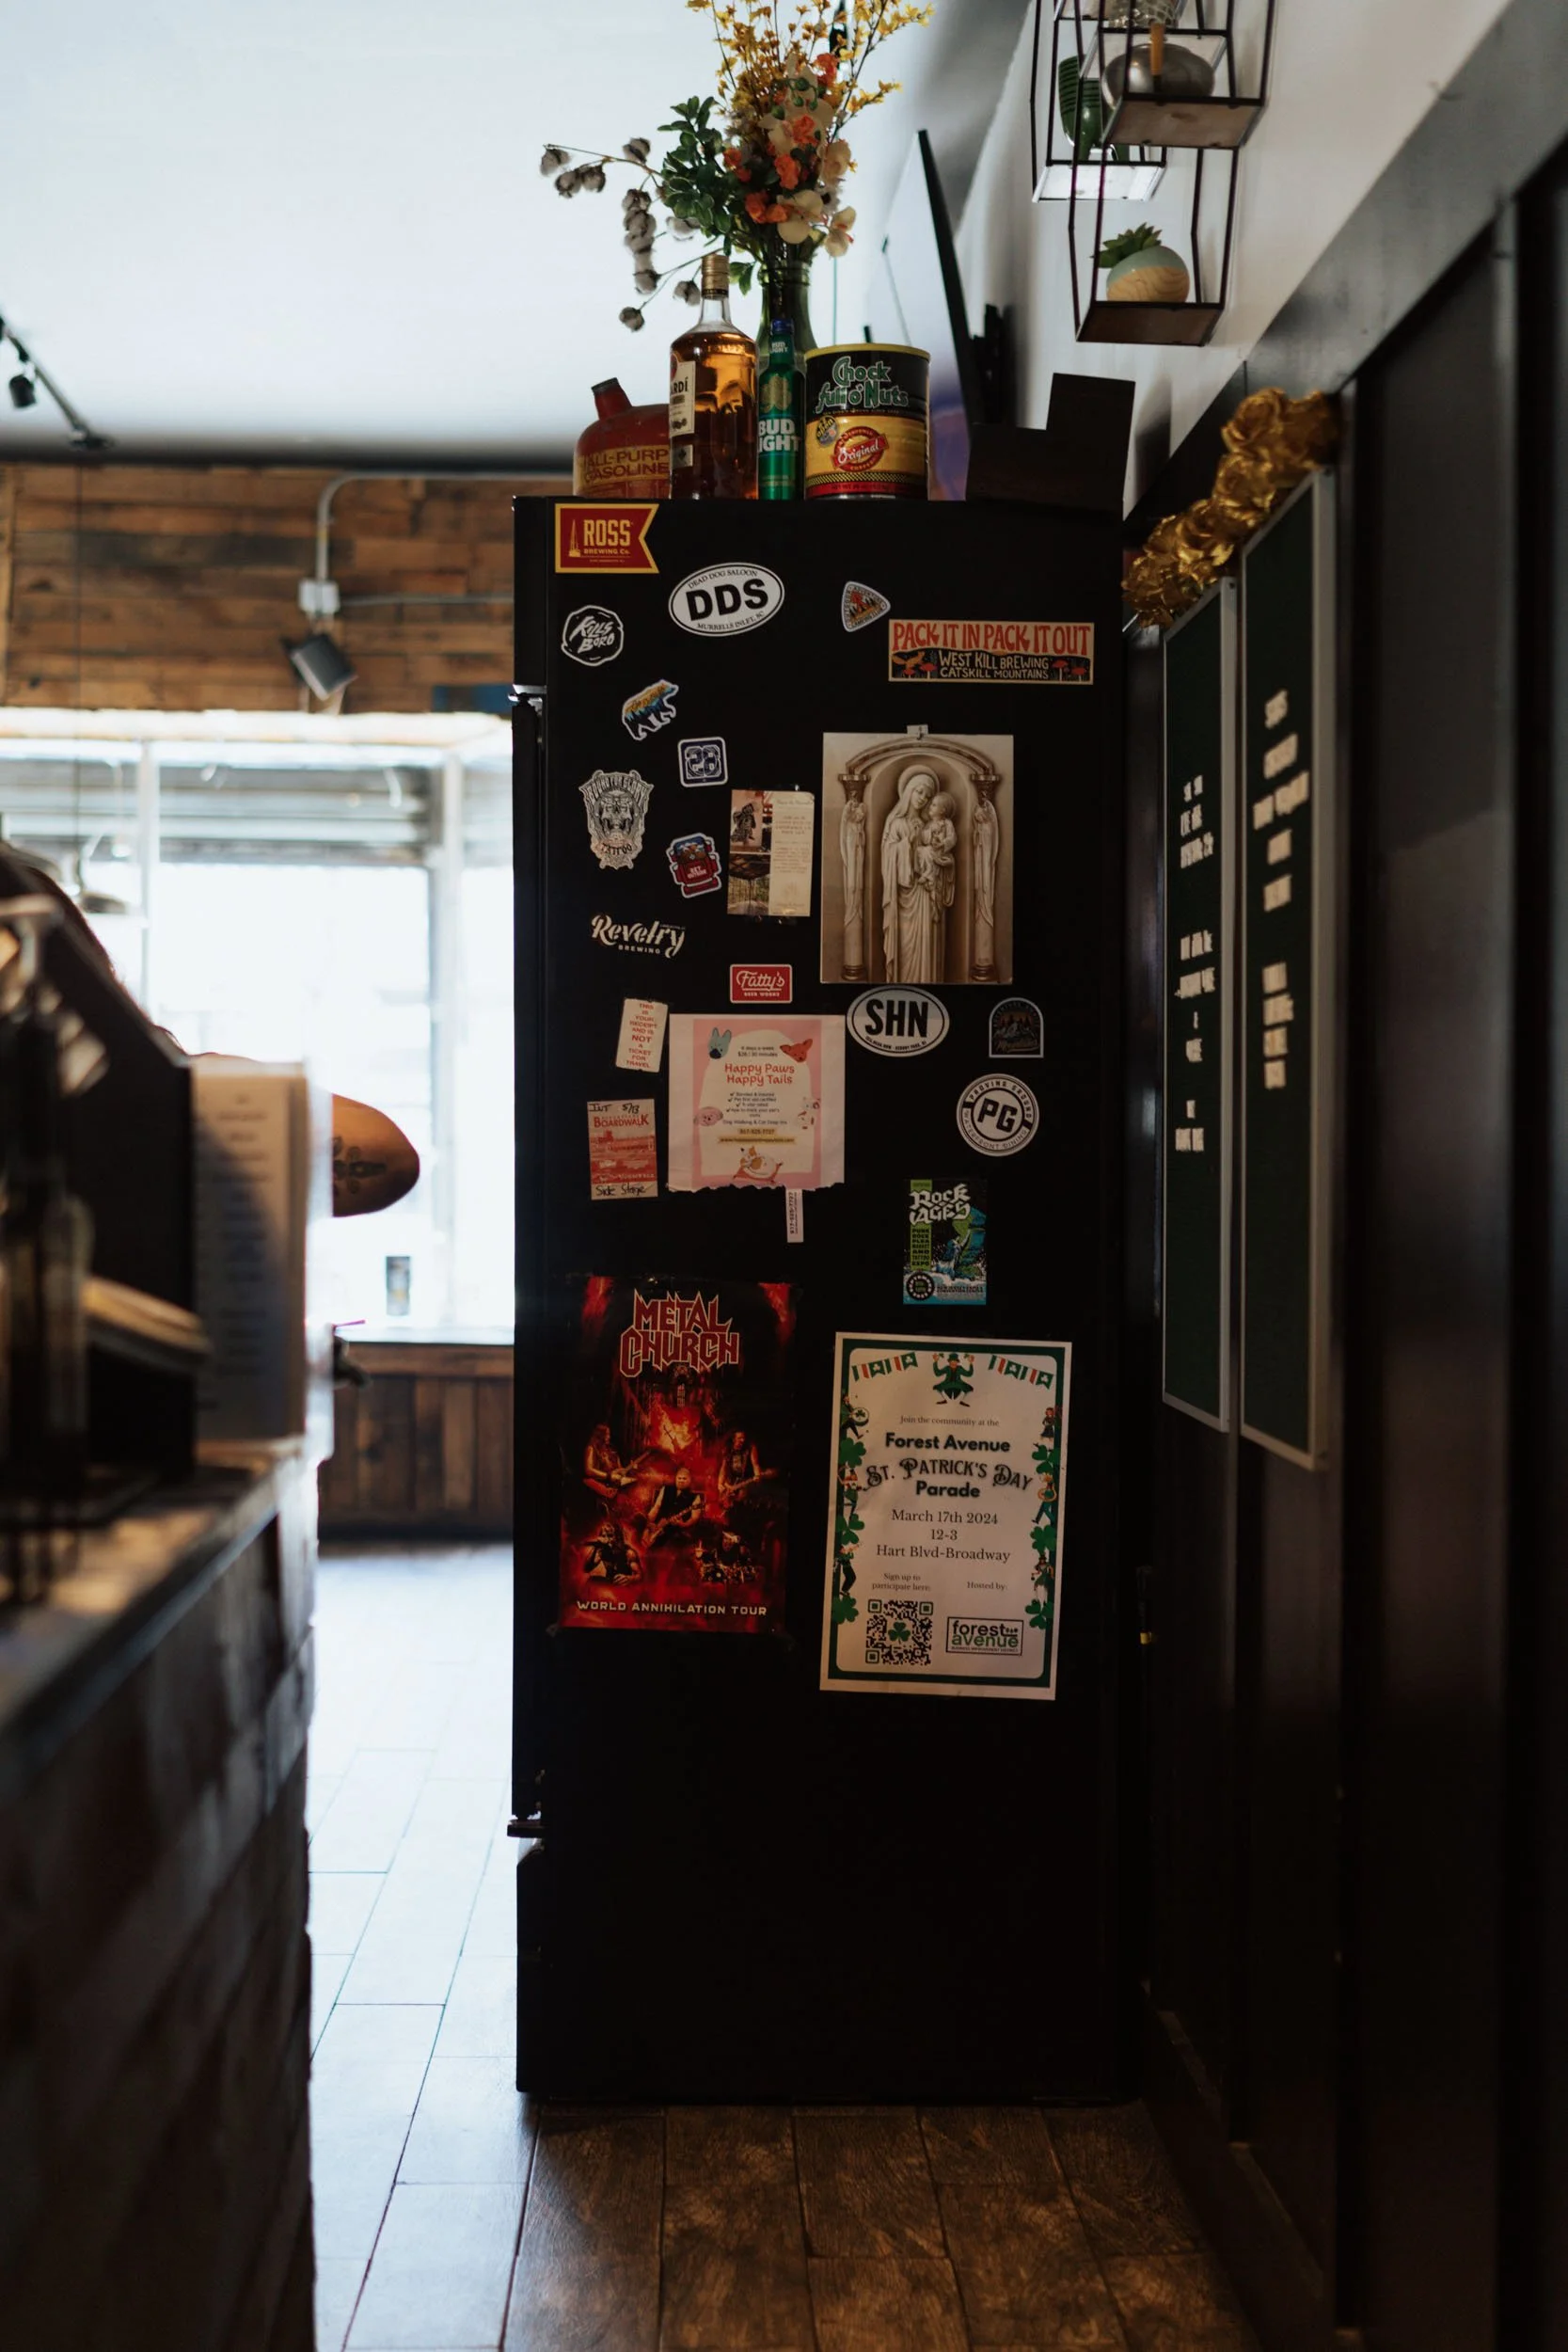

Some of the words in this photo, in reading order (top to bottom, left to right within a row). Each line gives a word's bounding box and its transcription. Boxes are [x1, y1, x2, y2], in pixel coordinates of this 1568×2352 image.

[832, 356, 892, 389] Chock
[671, 376, 689, 393] RDÍ
[758, 418, 796, 437] BUD
[758, 435, 801, 453] IGHT
[838, 437, 879, 465] Original
[583, 518, 631, 547] ROSS
[689, 575, 709, 589] DEAD
[708, 569, 726, 580] DOG
[727, 567, 758, 578] SALOON
[685, 578, 769, 621] DDS
[697, 621, 734, 631] MURRELLS
[577, 632, 615, 654] BORO
[893, 622, 941, 651] PACK
[942, 624, 959, 649] IT
[961, 624, 980, 650] IN
[984, 624, 1031, 652] PACK
[1034, 625, 1053, 654] IT
[1053, 625, 1092, 656] OUT
[940, 650, 972, 667] WEST
[974, 651, 999, 670] KILL
[1000, 656, 1049, 670] BREWING
[941, 666, 992, 678] CATSKILL
[993, 668, 1049, 679] MOUNTAINS
[591, 914, 686, 959] Revelry
[618, 945, 661, 954] BREWING
[736, 970, 785, 992] Fatty's
[864, 998, 929, 1039] SHN
[631, 1035, 652, 1043] NOT
[724, 1063, 762, 1075] Happy
[765, 1063, 795, 1074] Paws
[726, 1074, 765, 1087] Happy
[766, 1074, 793, 1085] Tails
[969, 1080, 1007, 1102] PROVING
[1011, 1083, 1033, 1119] GROUND
[594, 1113, 649, 1127] BOARDWALK
[977, 1098, 1019, 1133] PG
[633, 1288, 734, 1338] METAL
[619, 1325, 740, 1378] CHURCH
[899, 1415, 916, 1424] Join
[931, 1417, 976, 1427] community
[885, 1432, 940, 1450] Forest
[943, 1435, 1011, 1453] Avenue
[915, 1480, 981, 1498] Parade
[891, 1509, 933, 1522] March
[937, 1511, 962, 1524] 17th
[966, 1513, 999, 1525] 2024
[931, 1529, 958, 1541] 12-3
[876, 1545, 906, 1557] Hart
[910, 1546, 1011, 1564] Blvd-Broadway
[872, 1581, 911, 1591] participate
[883, 1573, 900, 1582] Sign
[967, 1581, 994, 1590] Hosted
[577, 1600, 627, 1612] WORLD
[631, 1602, 726, 1615] ANNIHILATION
[731, 1605, 768, 1616] TOUR
[953, 1619, 1006, 1637] forest
[951, 1634, 1019, 1648] avenue
